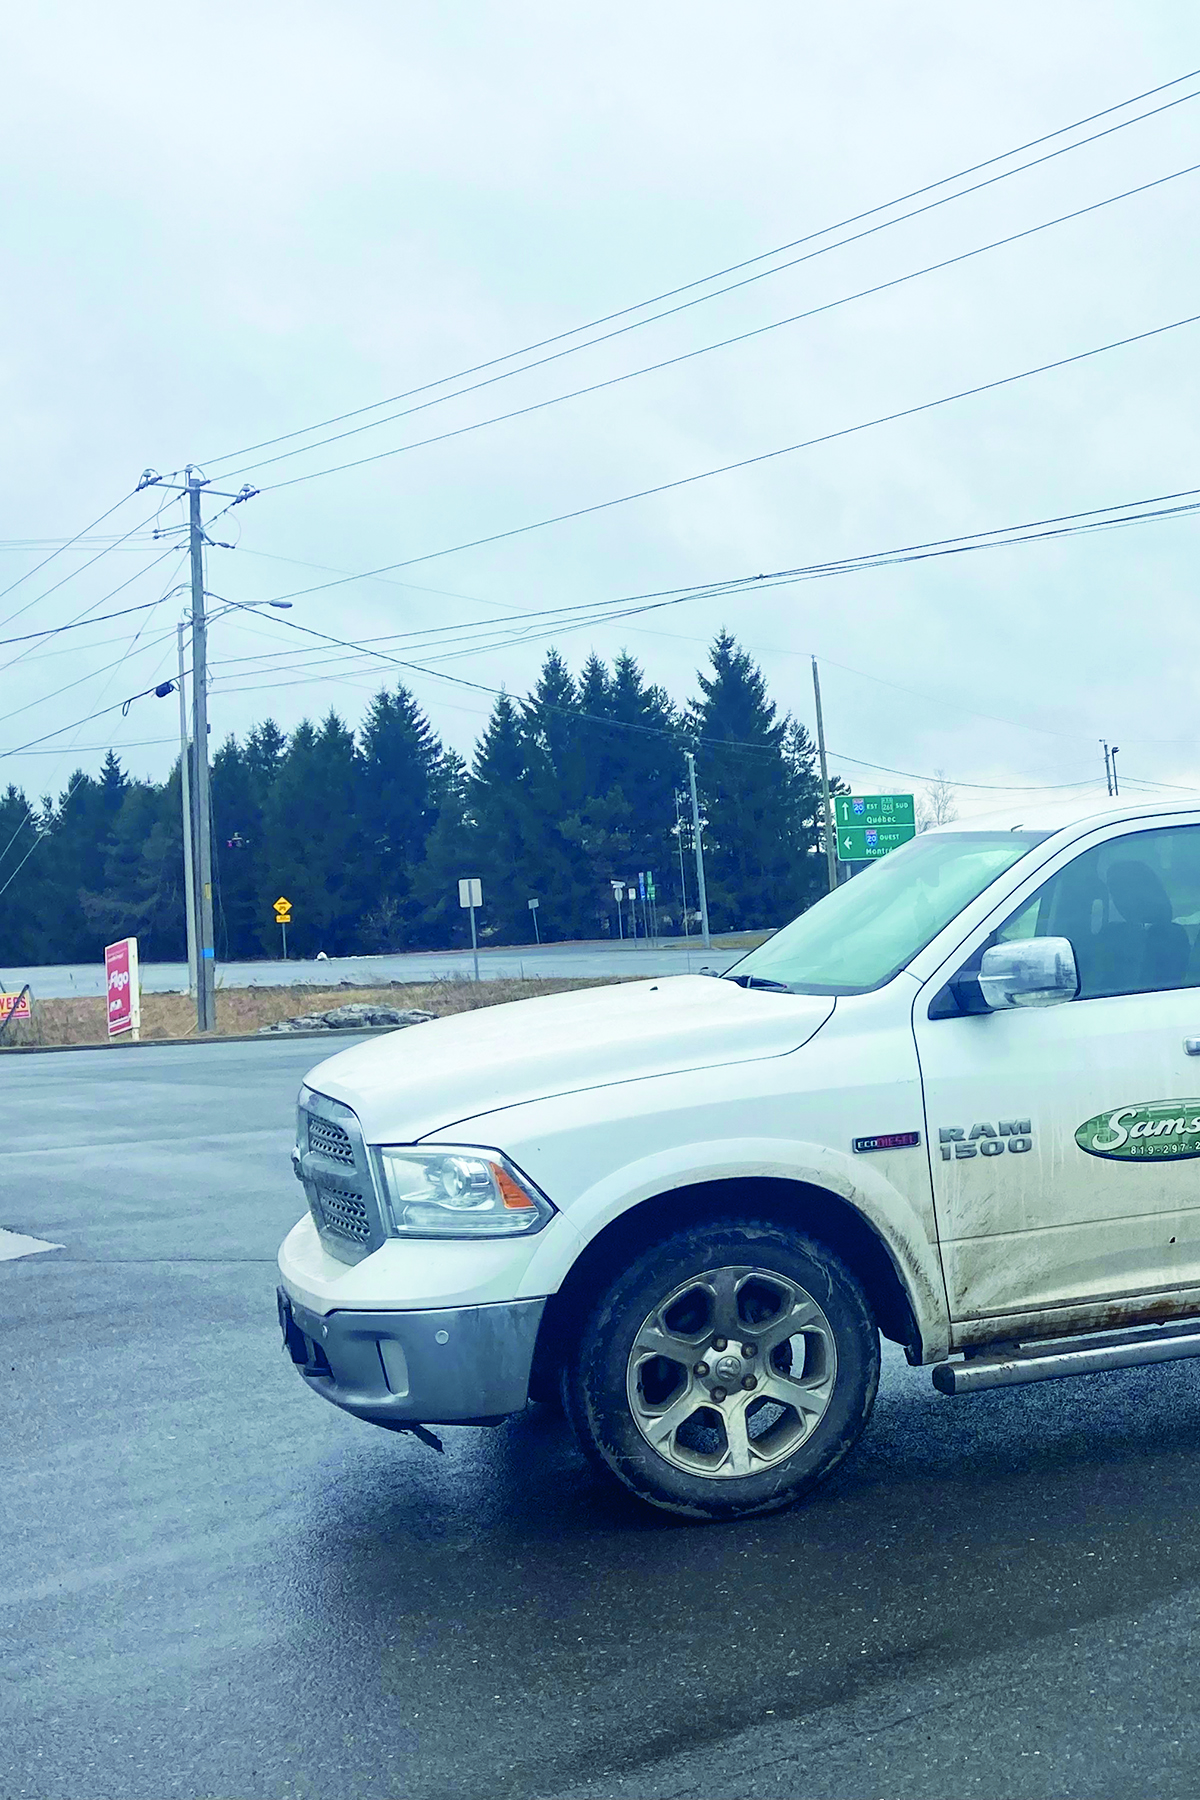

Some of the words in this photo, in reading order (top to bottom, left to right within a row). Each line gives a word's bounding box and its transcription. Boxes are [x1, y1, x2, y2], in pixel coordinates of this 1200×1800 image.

[866, 816, 896, 824] Québec
[938, 1118, 1032, 1143] RAM
[857, 1134, 916, 1149] ECODIESEL
[940, 1136, 1033, 1161] 1500
